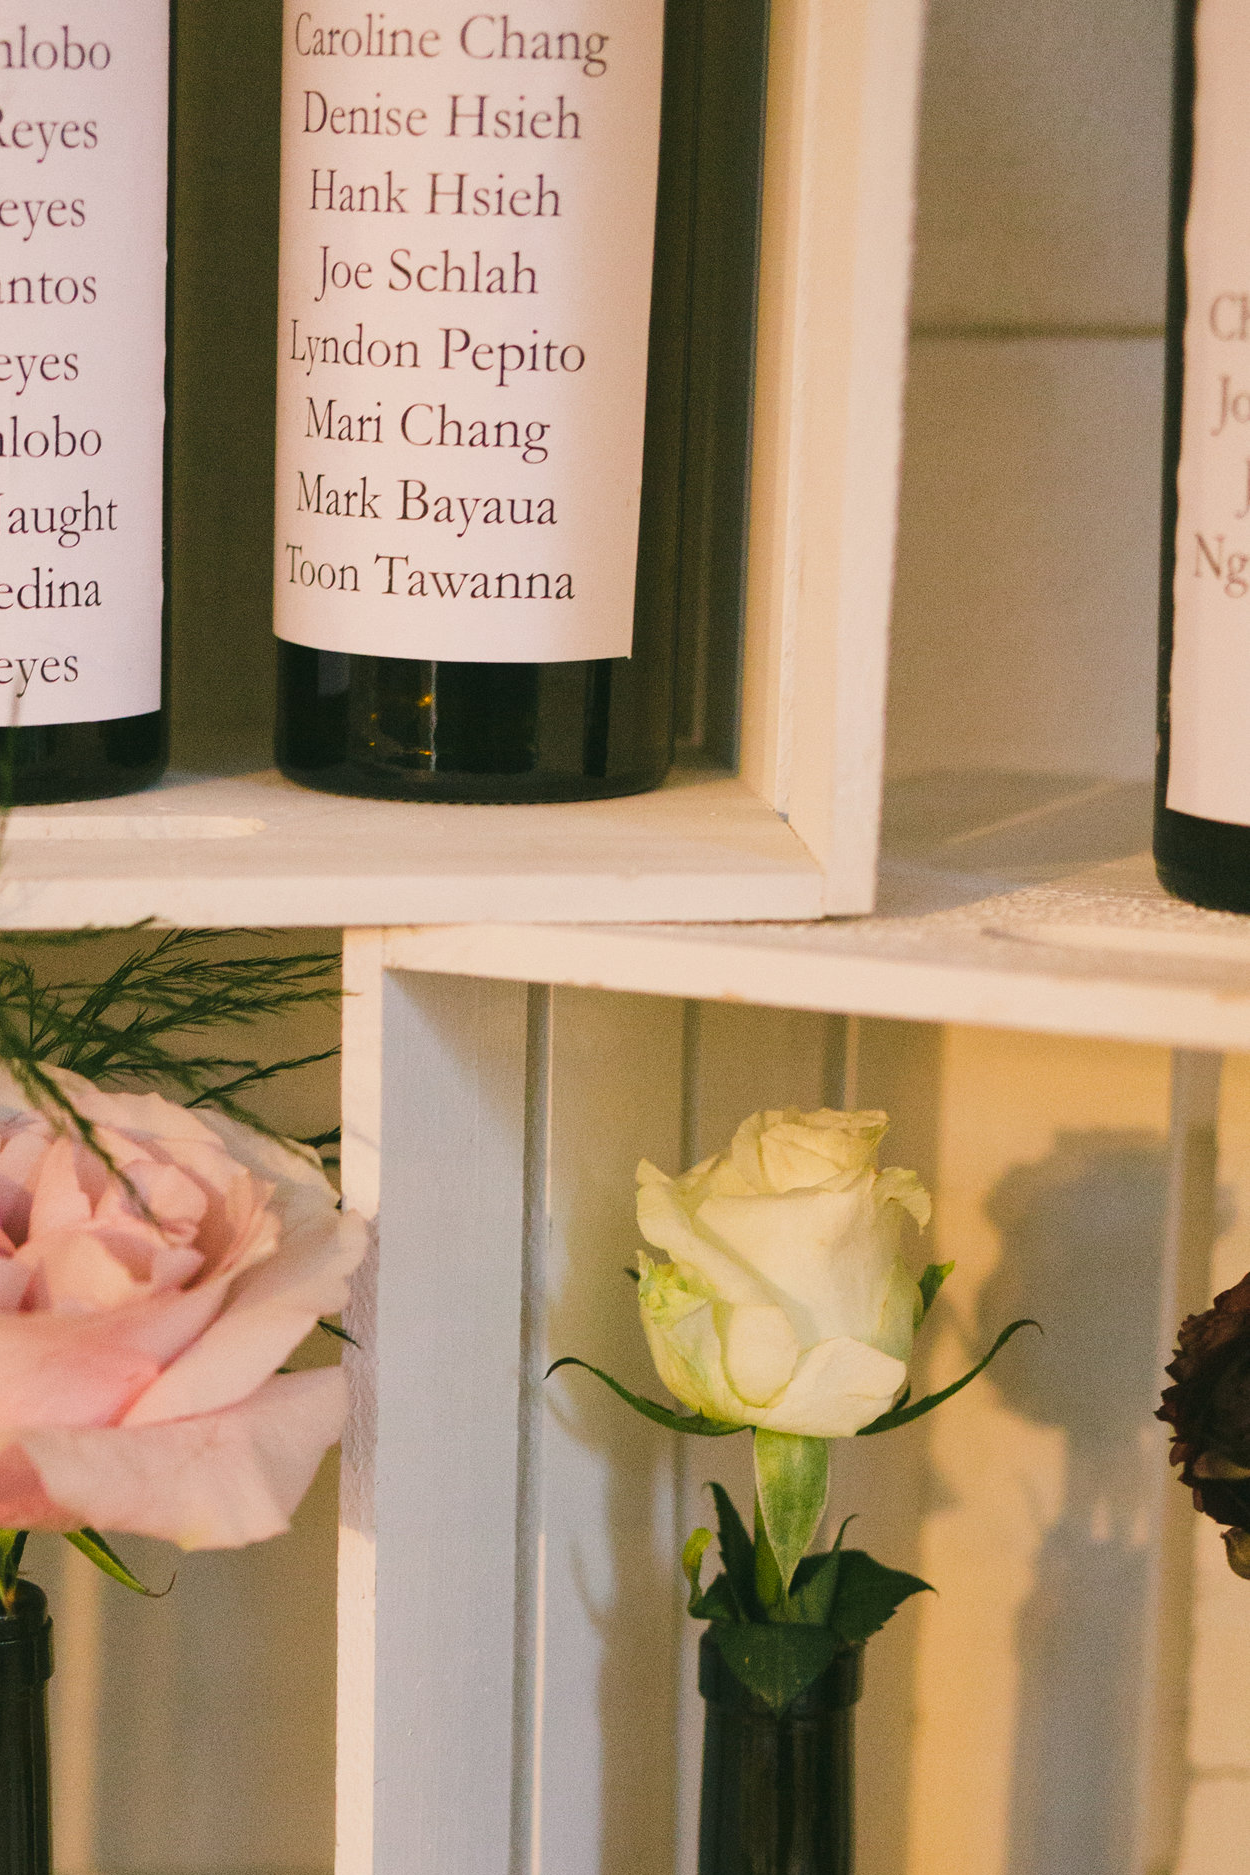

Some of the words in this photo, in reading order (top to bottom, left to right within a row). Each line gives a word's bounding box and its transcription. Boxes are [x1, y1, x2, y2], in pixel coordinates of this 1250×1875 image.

[295, 11, 442, 58] Caroline
[459, 14, 610, 78] Chang
[302, 90, 429, 136] Denise
[445, 93, 583, 140] Hsieh
[309, 168, 410, 213] Hank
[425, 171, 561, 217] Hsieh
[314, 245, 373, 302] Joe
[388, 247, 540, 295] Schlah
[289, 319, 421, 377] Lyndon
[439, 327, 587, 388] Pepito
[304, 396, 384, 443] Mari
[400, 402, 552, 465] Chang
[296, 471, 383, 519] Mark
[397, 478, 558, 538] Bayaua
[285, 544, 362, 592] Toon
[374, 554, 576, 600] Tawanna
